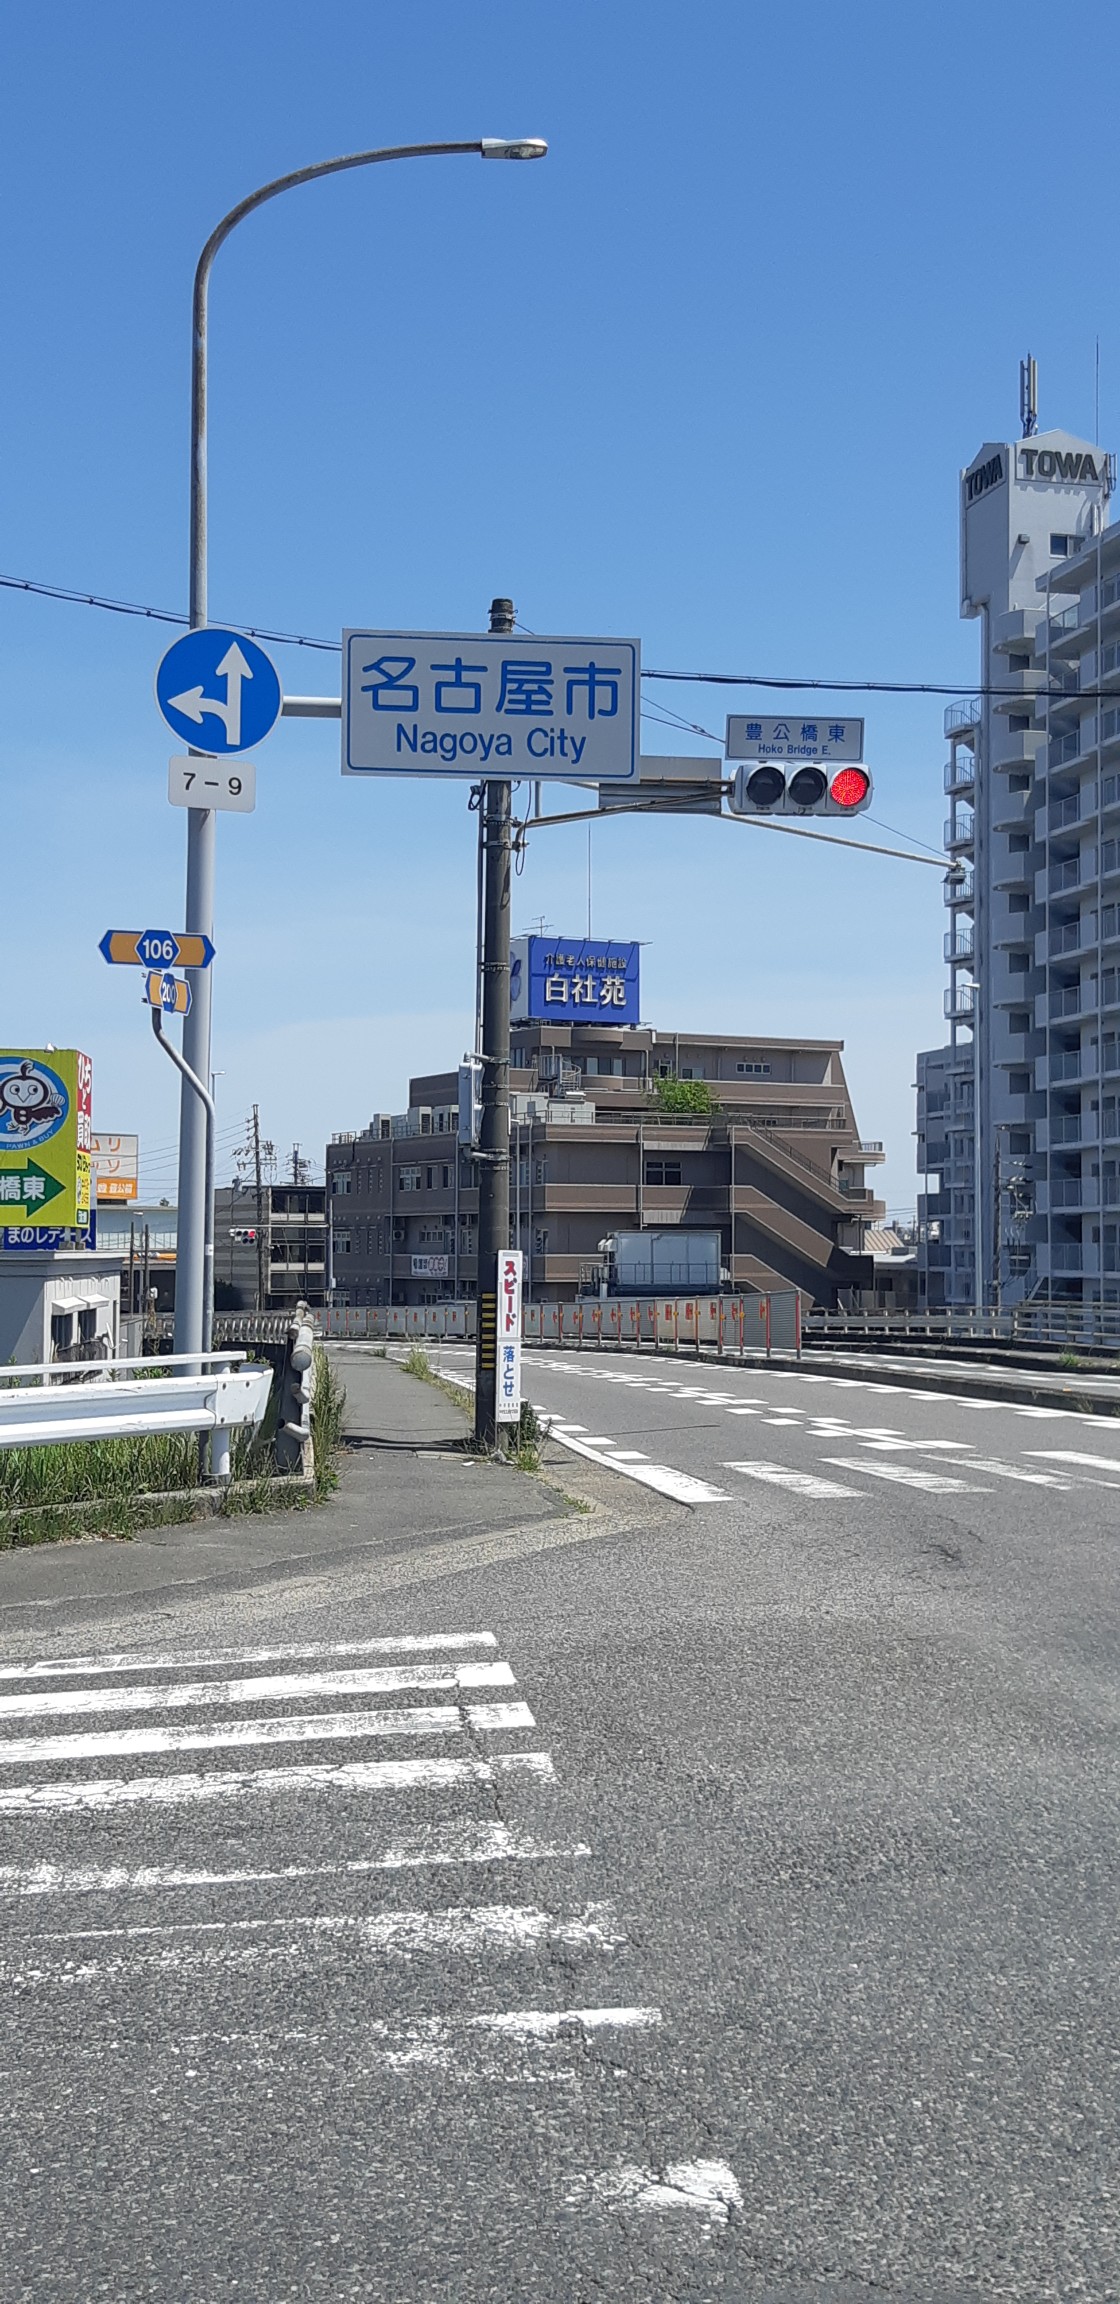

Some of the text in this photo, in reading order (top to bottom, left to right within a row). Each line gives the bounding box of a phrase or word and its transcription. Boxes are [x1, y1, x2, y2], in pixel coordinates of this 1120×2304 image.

[966, 454, 1003, 501] TOWA
[1021, 448, 1098, 481] TOWA
[361, 656, 622, 720] 名古屋市
[396, 723, 587, 764] Nagoya City
[745, 723, 846, 743] 豊公橋東
[758, 744, 831, 756] Hoko Bridge E.
[143, 939, 173, 960] 106
[545, 953, 627, 968] 介護老人保健施設
[162, 981, 176, 1004] 200
[545, 972, 627, 1006] 白社苑
[6, 1141, 31, 1149] PAWN
[38, 1129, 54, 1142] BUY
[0, 1175, 46, 1201] 橋東
[503, 1260, 518, 1332] スピード
[502, 1345, 515, 1397] 落とせ
